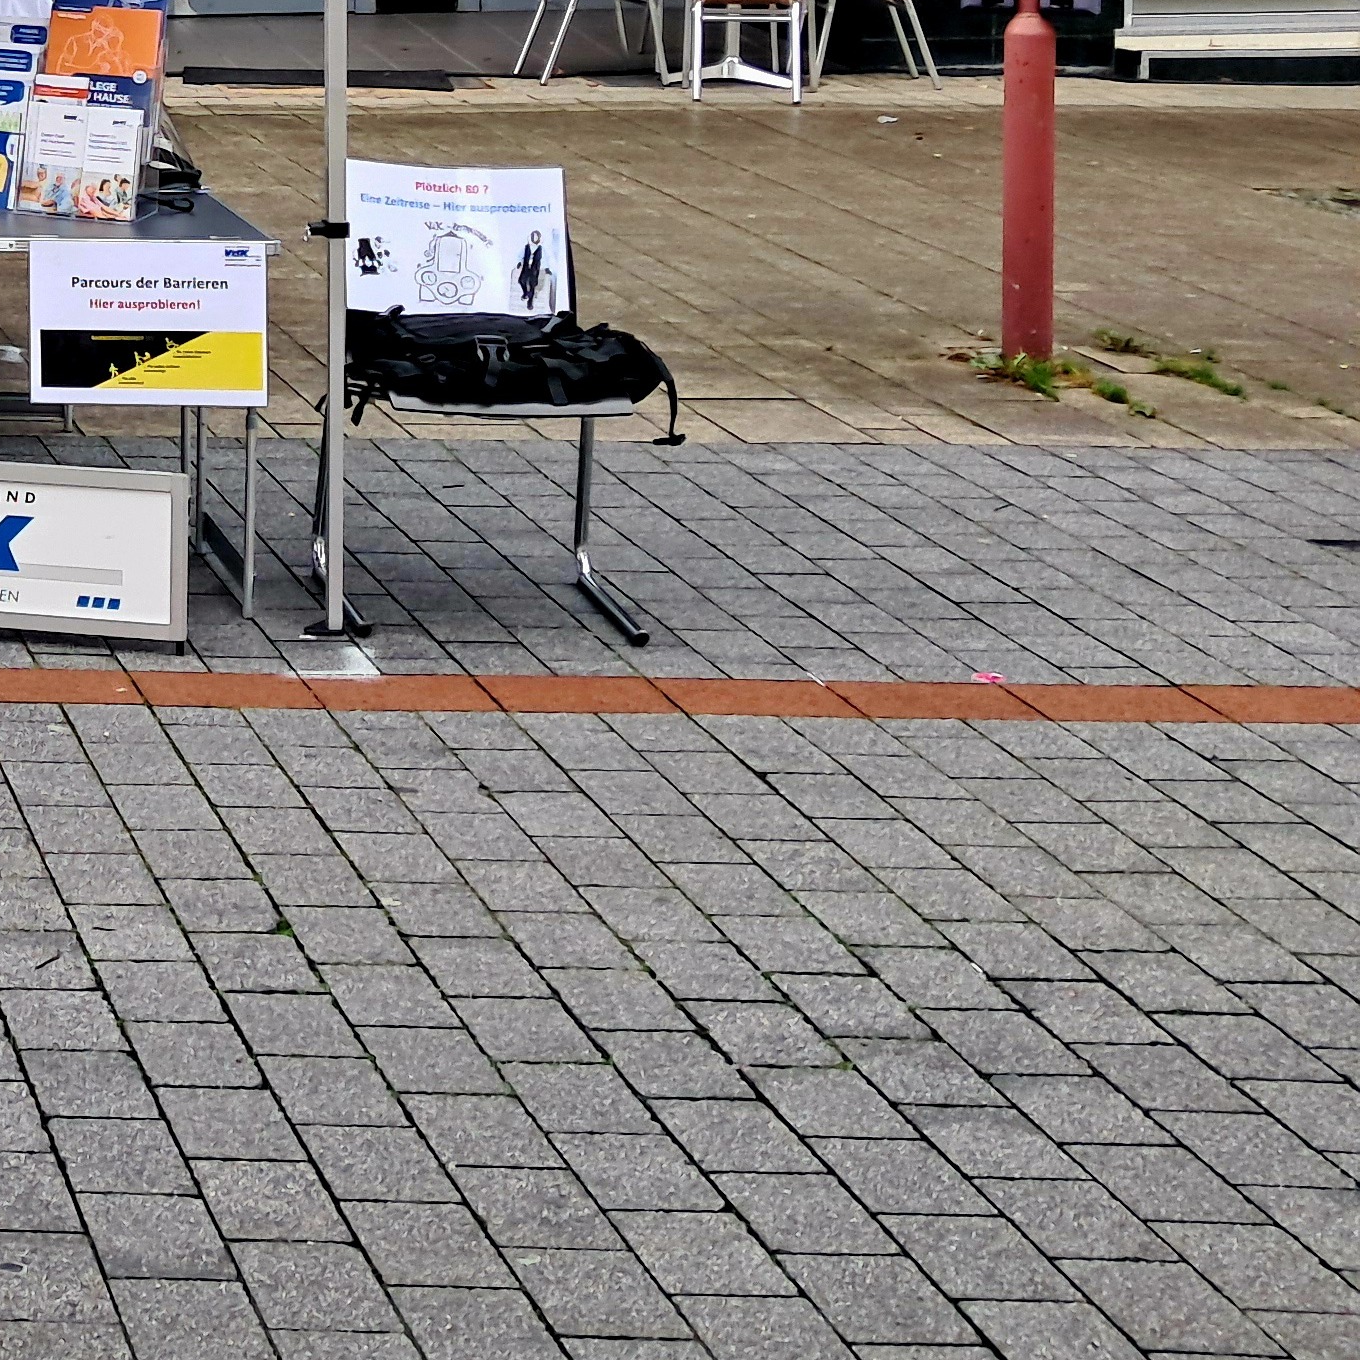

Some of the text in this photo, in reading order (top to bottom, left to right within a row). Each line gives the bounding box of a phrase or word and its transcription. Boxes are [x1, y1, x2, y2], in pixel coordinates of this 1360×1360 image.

[89, 80, 117, 92] LEGE
[72, 277, 228, 290] Parcours der Barrieren
[90, 299, 201, 311] Hier ausprobieren!
